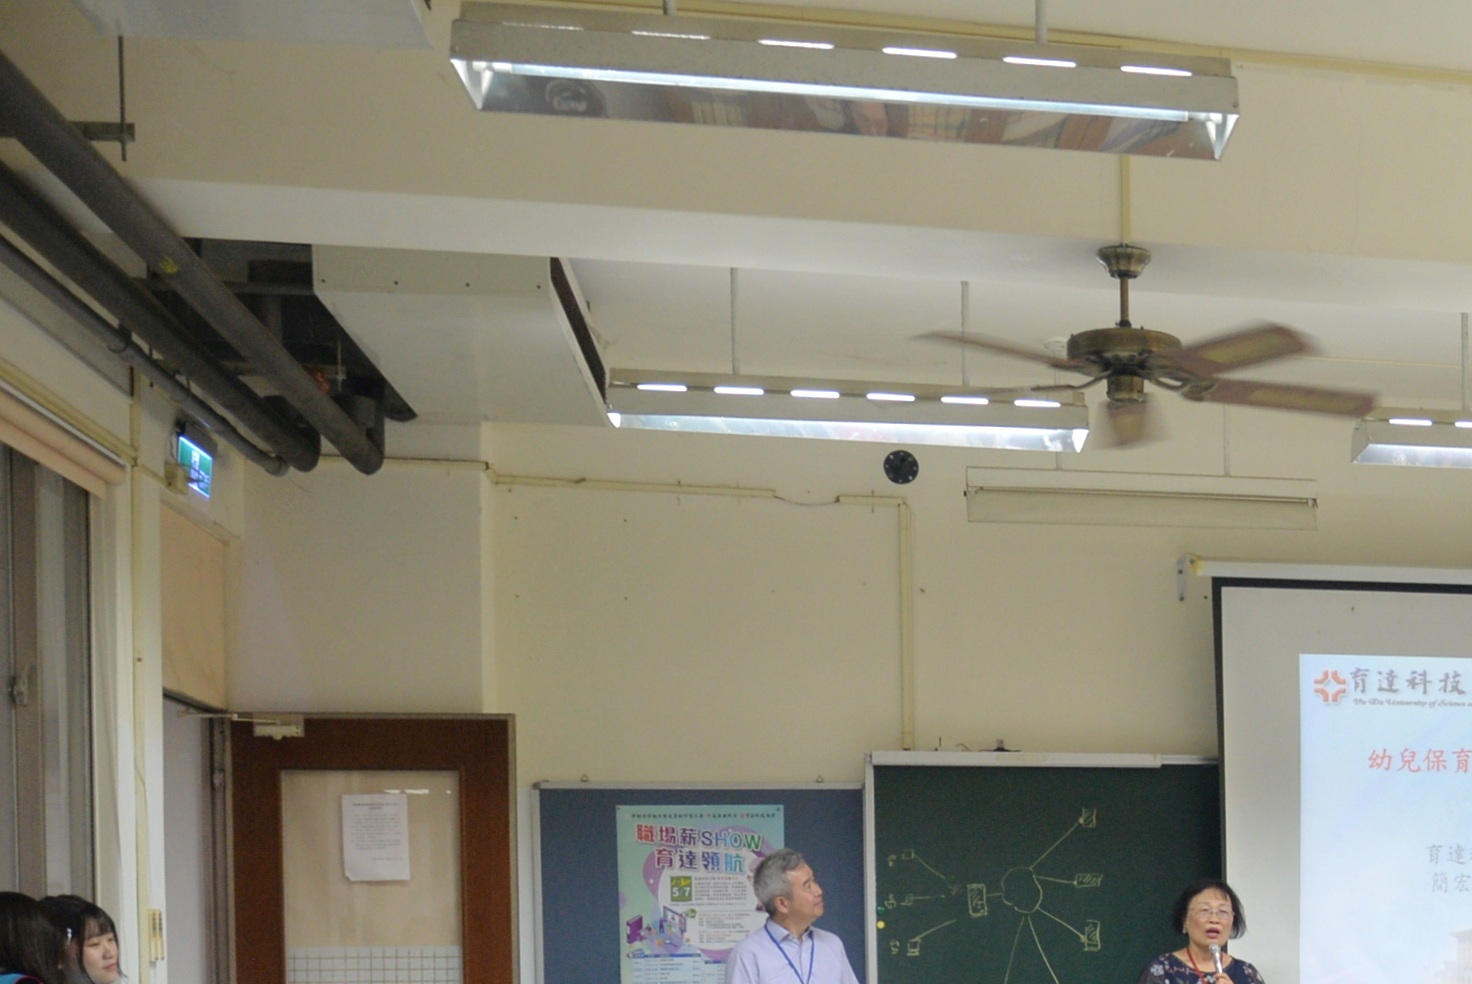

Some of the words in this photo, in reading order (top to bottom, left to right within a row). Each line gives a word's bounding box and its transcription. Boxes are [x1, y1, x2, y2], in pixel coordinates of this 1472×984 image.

[1385, 698, 1427, 708] University
[1438, 699, 1466, 707] Science
[636, 823, 763, 850] 職場薪SHOW
[655, 848, 744, 873] 育達領航
